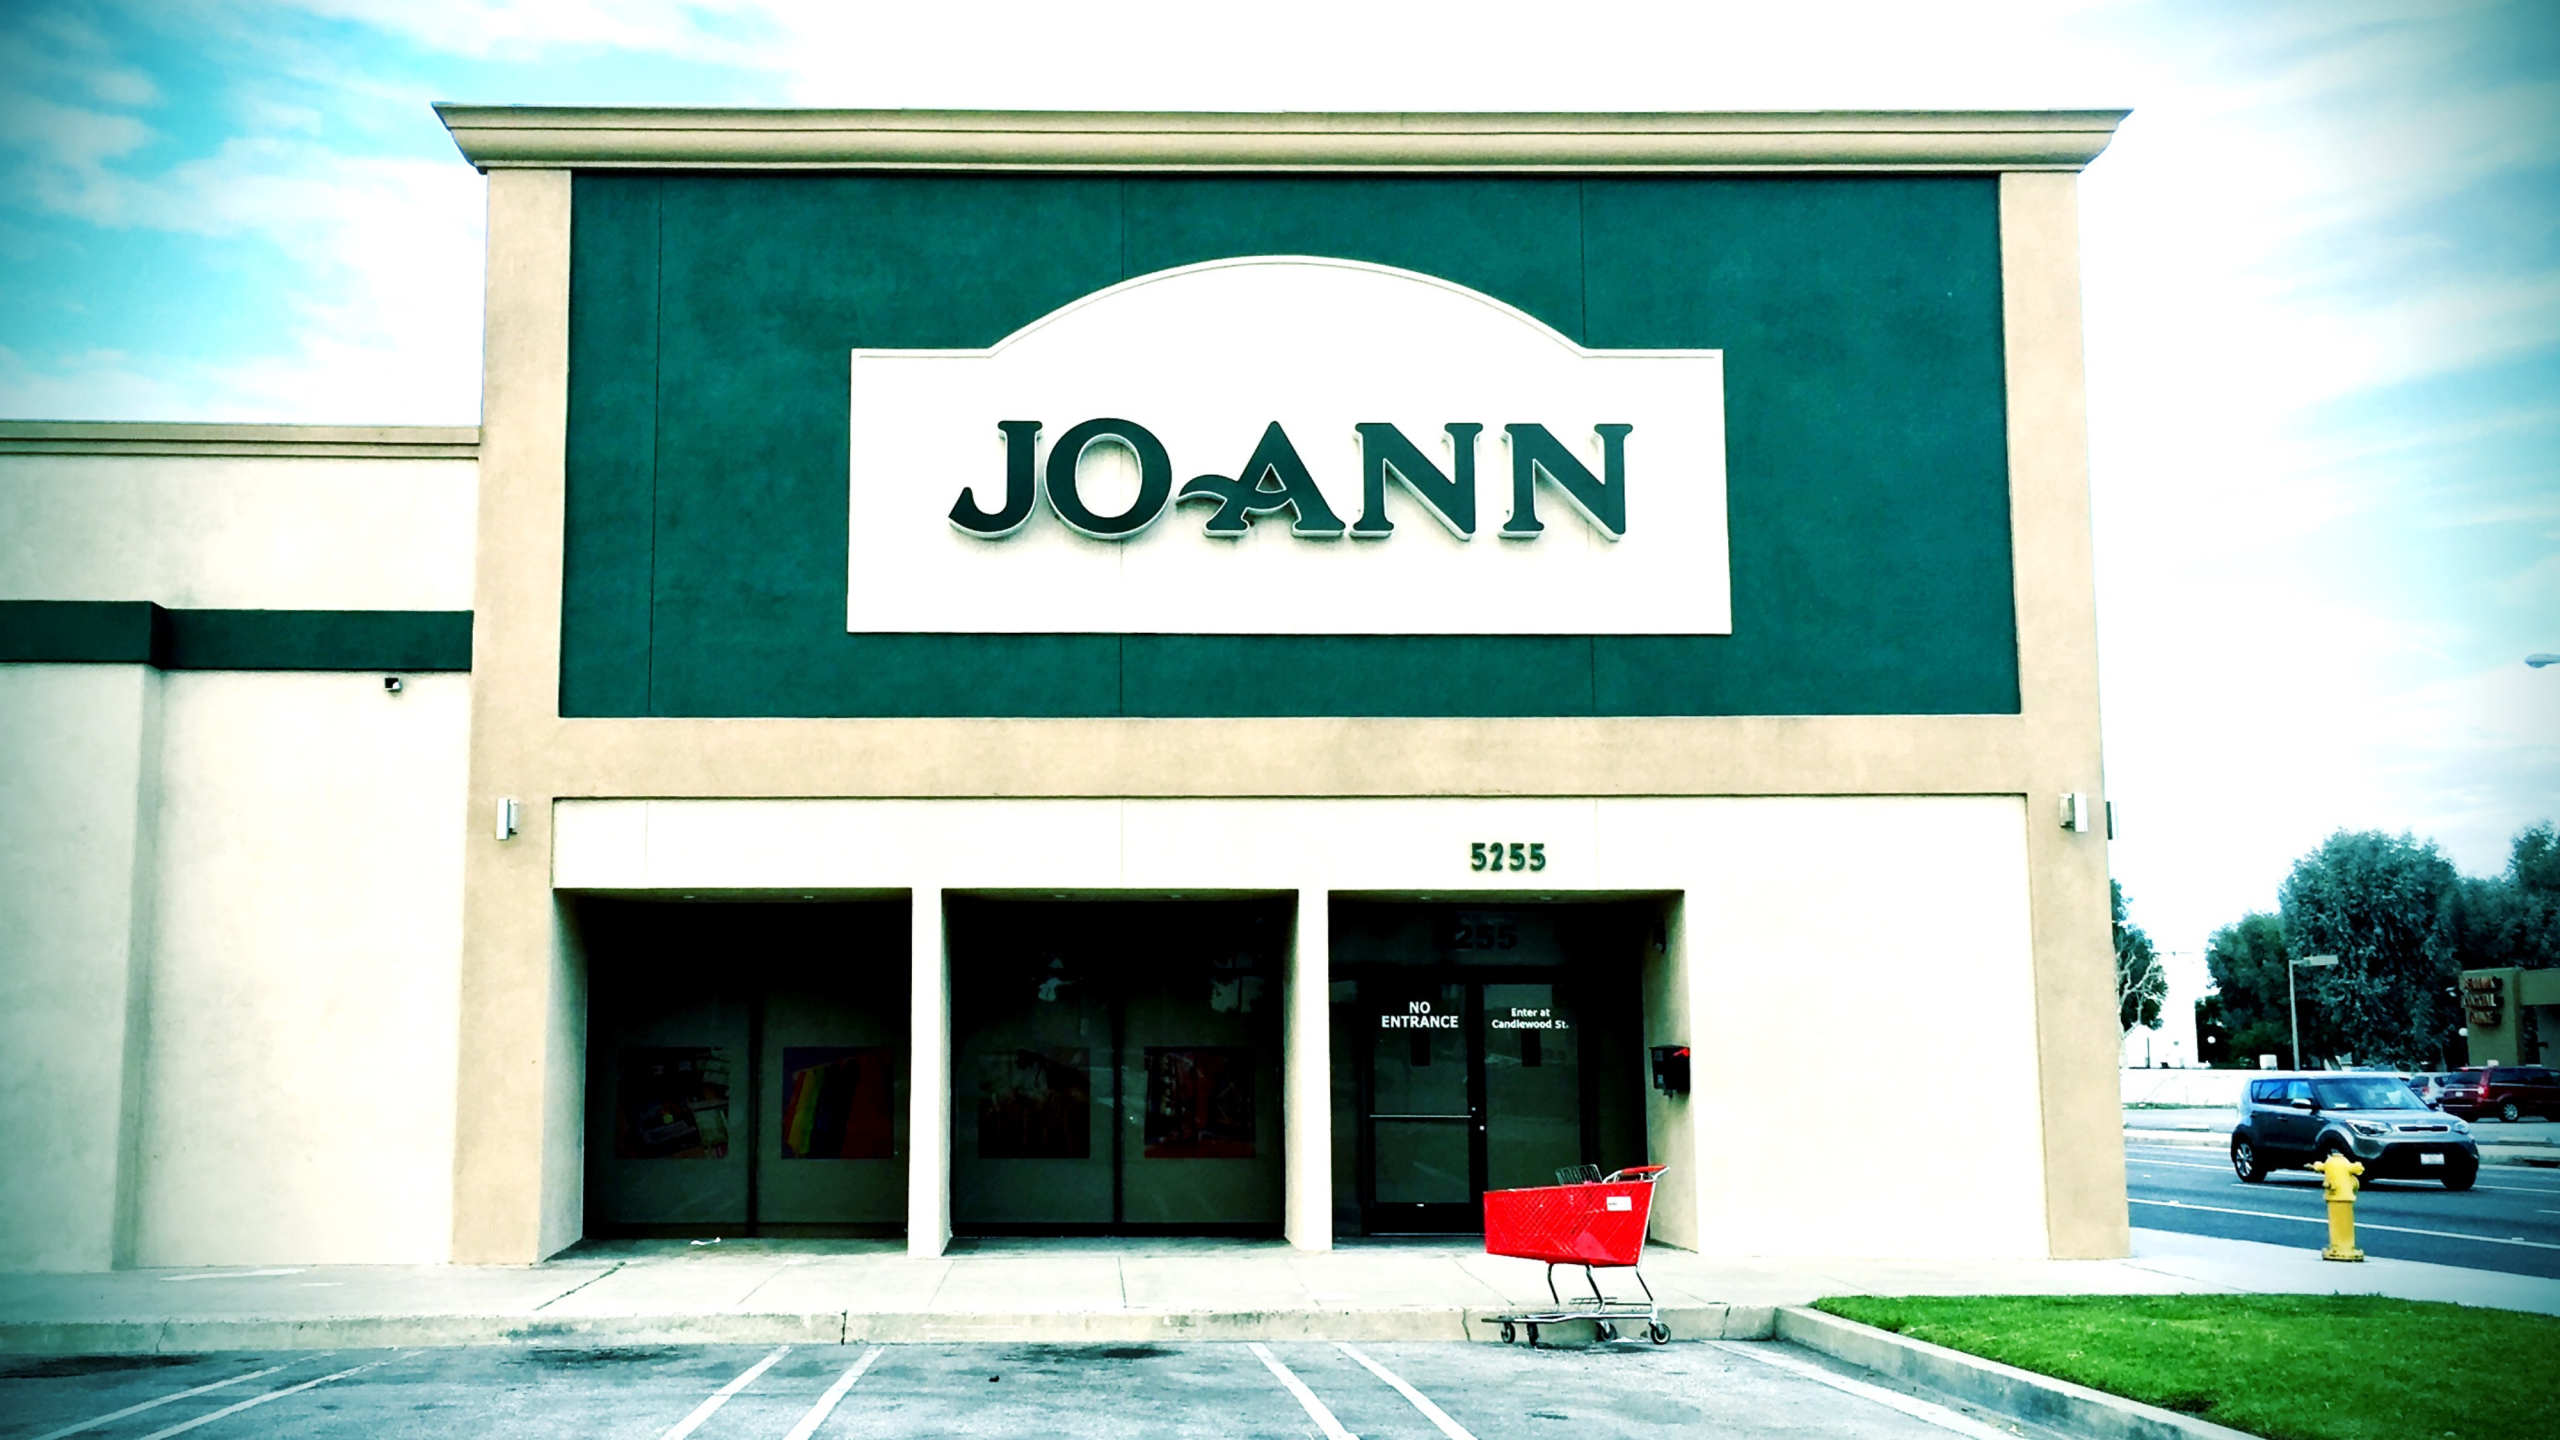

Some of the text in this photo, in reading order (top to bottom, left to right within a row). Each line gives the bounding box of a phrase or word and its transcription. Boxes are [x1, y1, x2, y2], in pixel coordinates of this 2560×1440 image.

[1470, 842, 1546, 872] 5255
[1409, 1001, 1431, 1014] NO
[1511, 1007, 1551, 1017] Enter at
[1381, 1015, 1459, 1029] ENTRANCE
[1491, 1018, 1569, 1029] Candlewood St.
